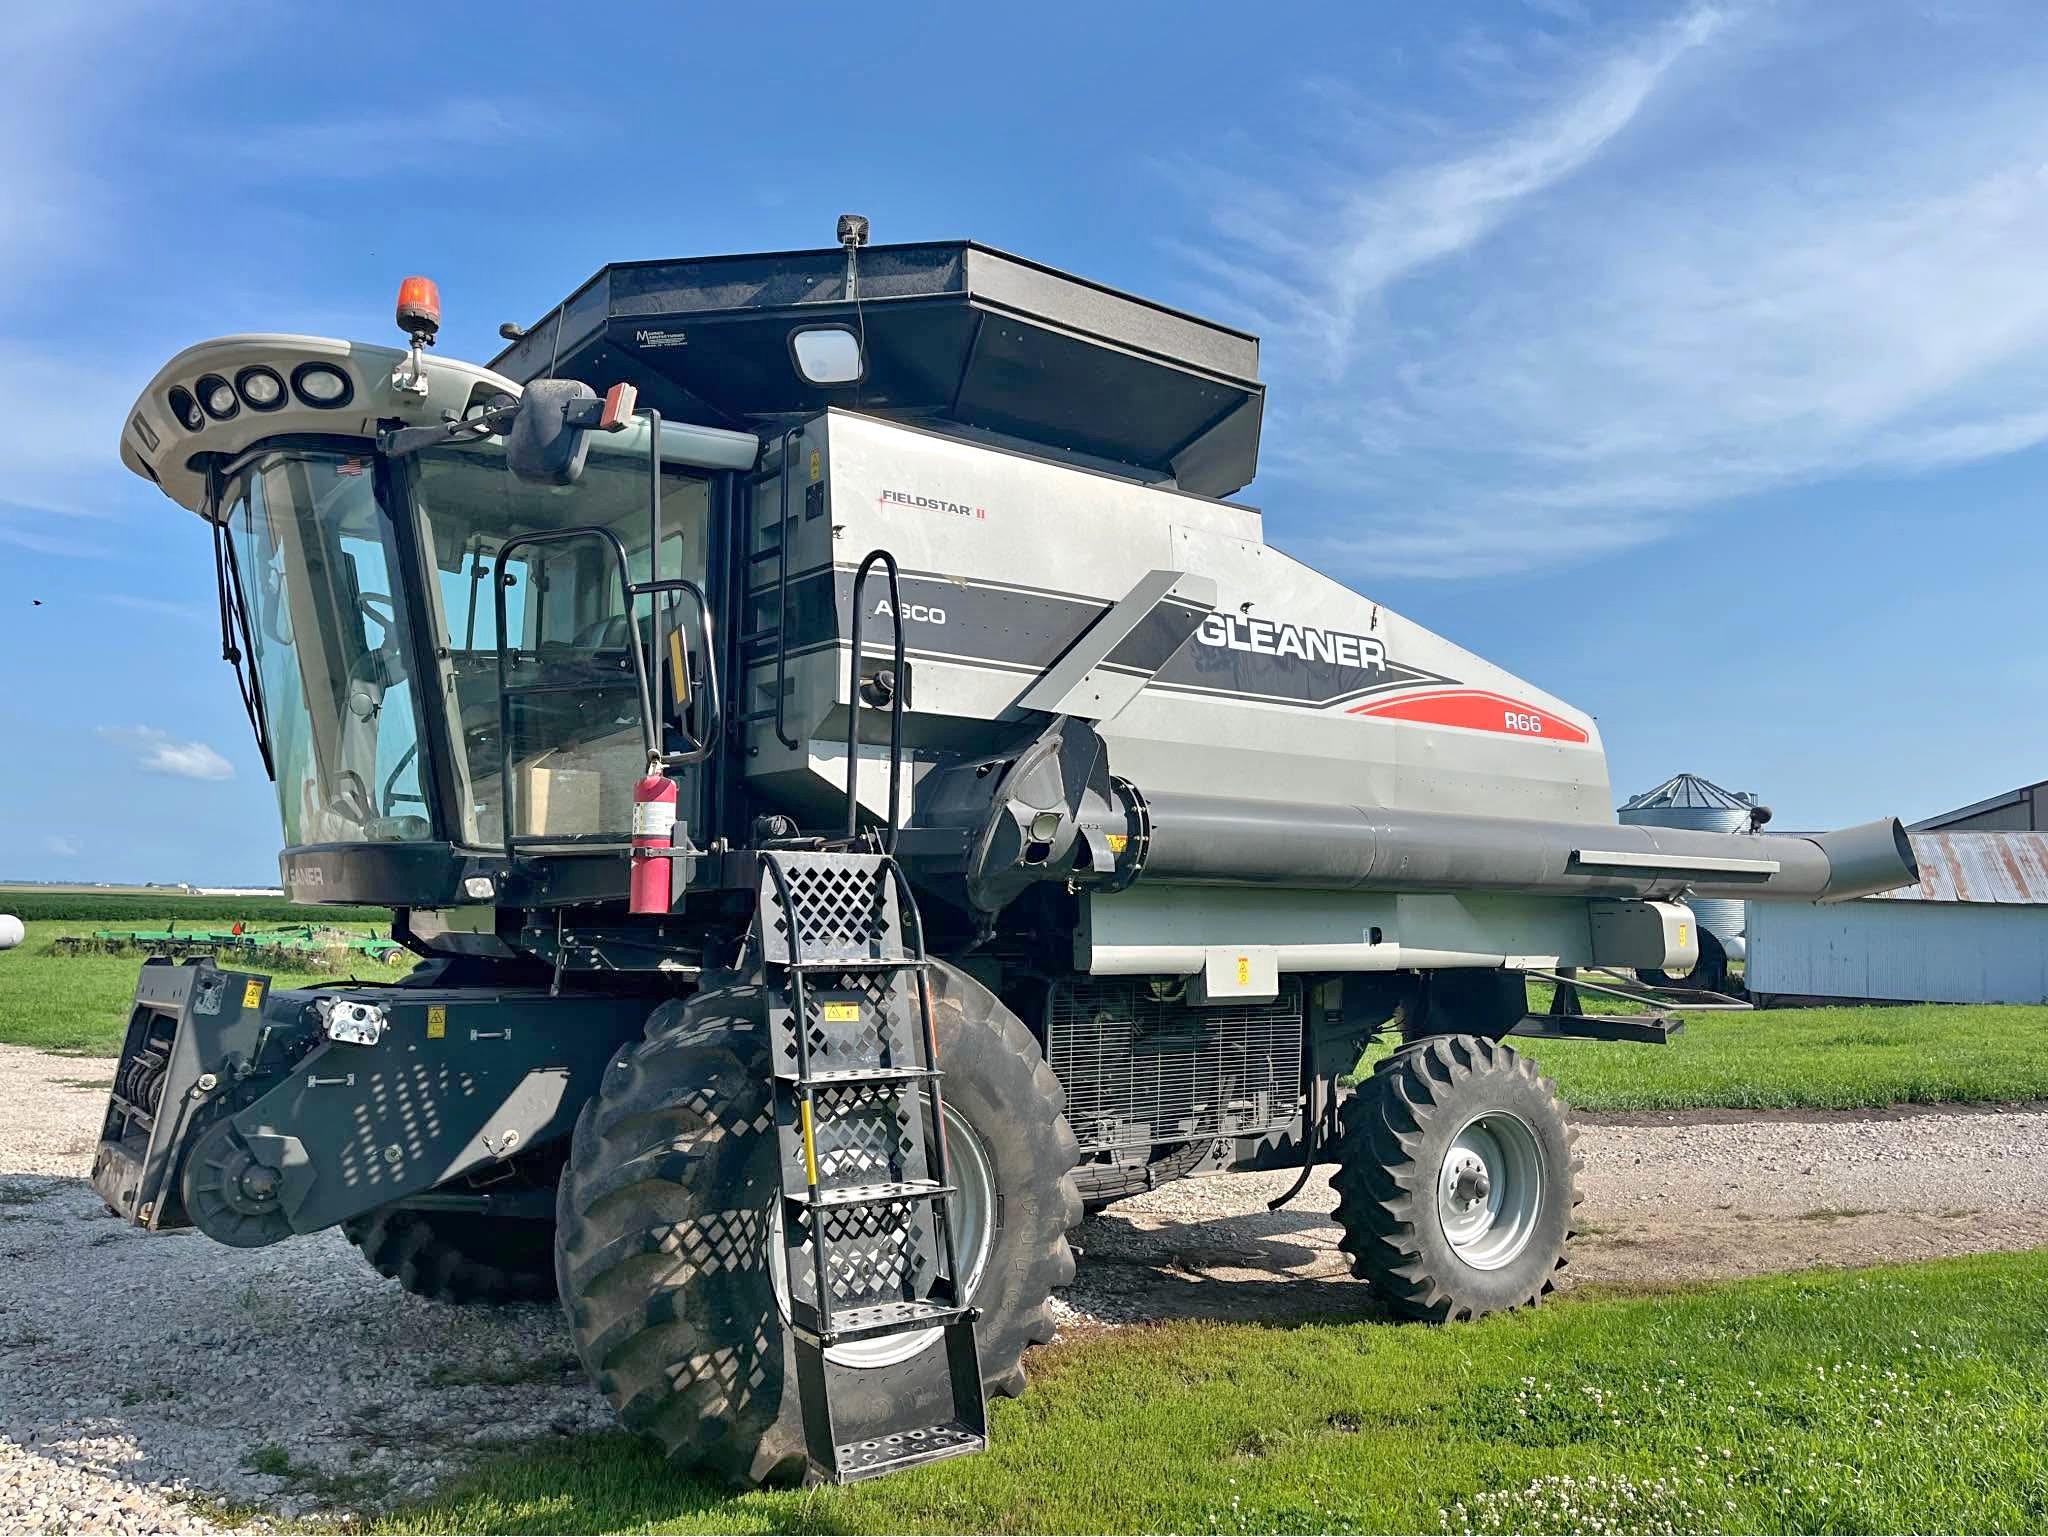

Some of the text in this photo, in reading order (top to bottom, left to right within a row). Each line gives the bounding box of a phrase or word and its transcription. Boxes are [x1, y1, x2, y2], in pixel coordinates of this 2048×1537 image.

[882, 489, 985, 520] FIELDSTAR II
[1196, 613, 1386, 672] GLEANER
[1504, 711, 1542, 733] R66
